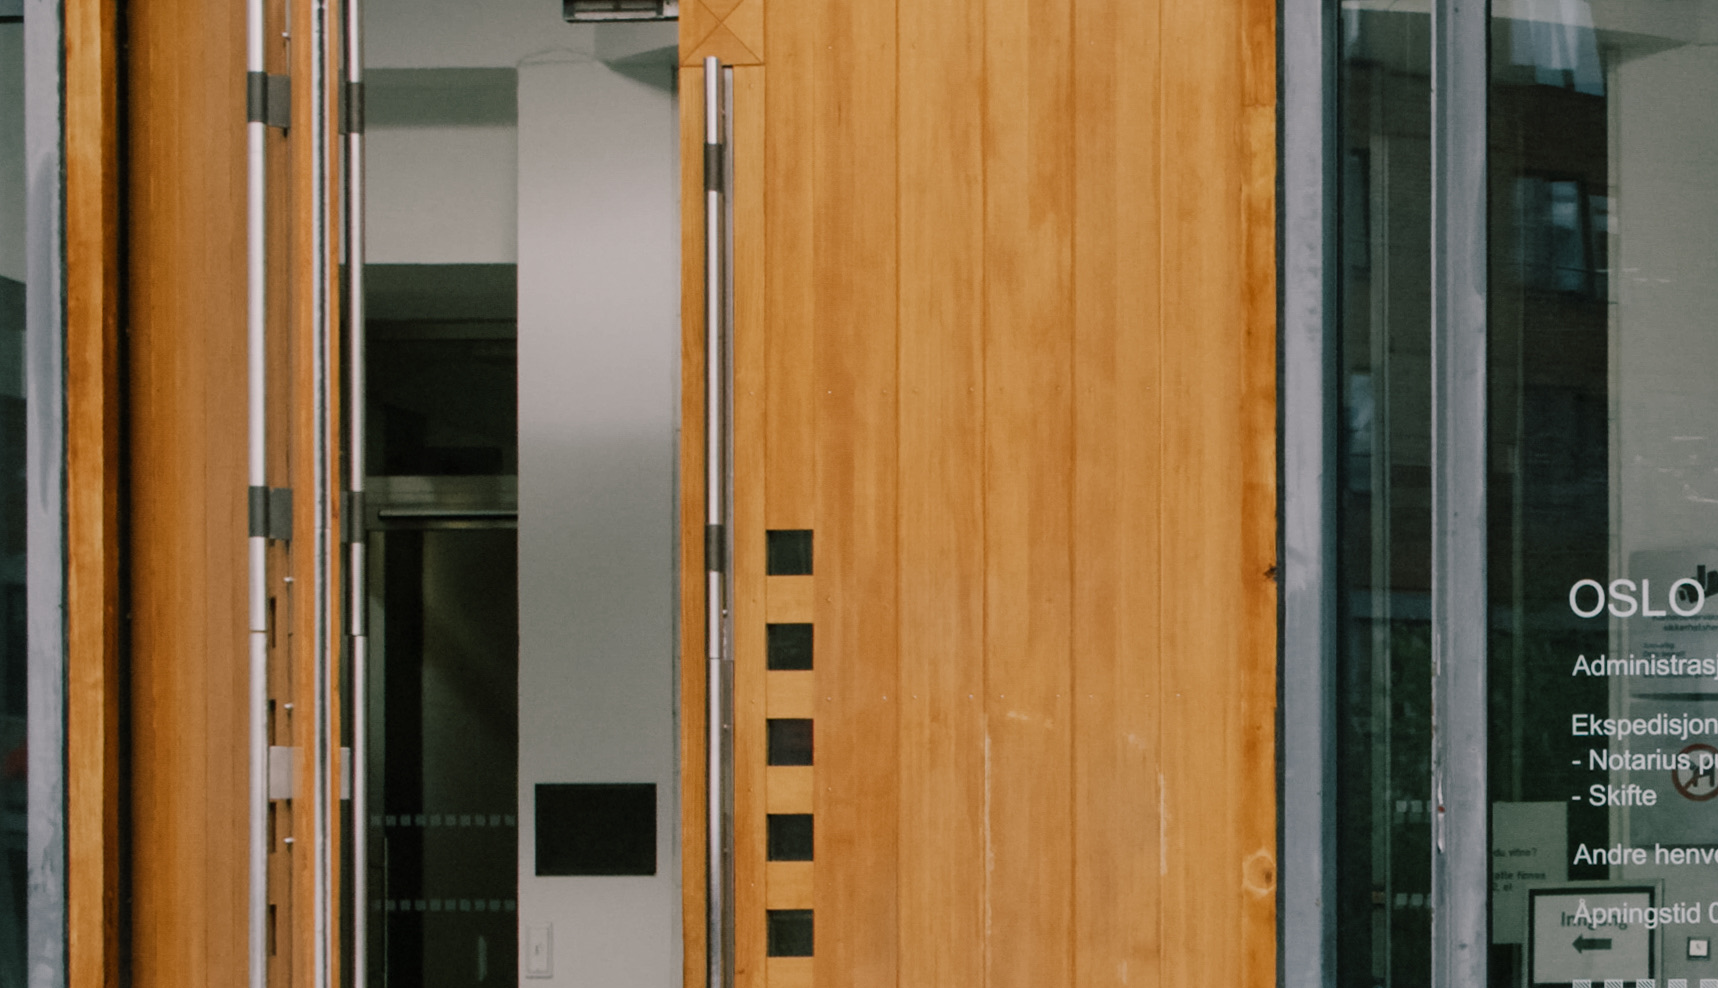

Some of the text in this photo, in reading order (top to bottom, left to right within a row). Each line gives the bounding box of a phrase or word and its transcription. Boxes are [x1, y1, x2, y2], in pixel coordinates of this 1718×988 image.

[1569, 577, 1705, 618] OSLO
[1572, 713, 1718, 741] Ekspedisjon
[1589, 748, 1691, 771] Notarius
[1589, 783, 1657, 806] Skifte
[1573, 843, 1647, 866] Andre
[1573, 898, 1701, 930] Åpningstid
